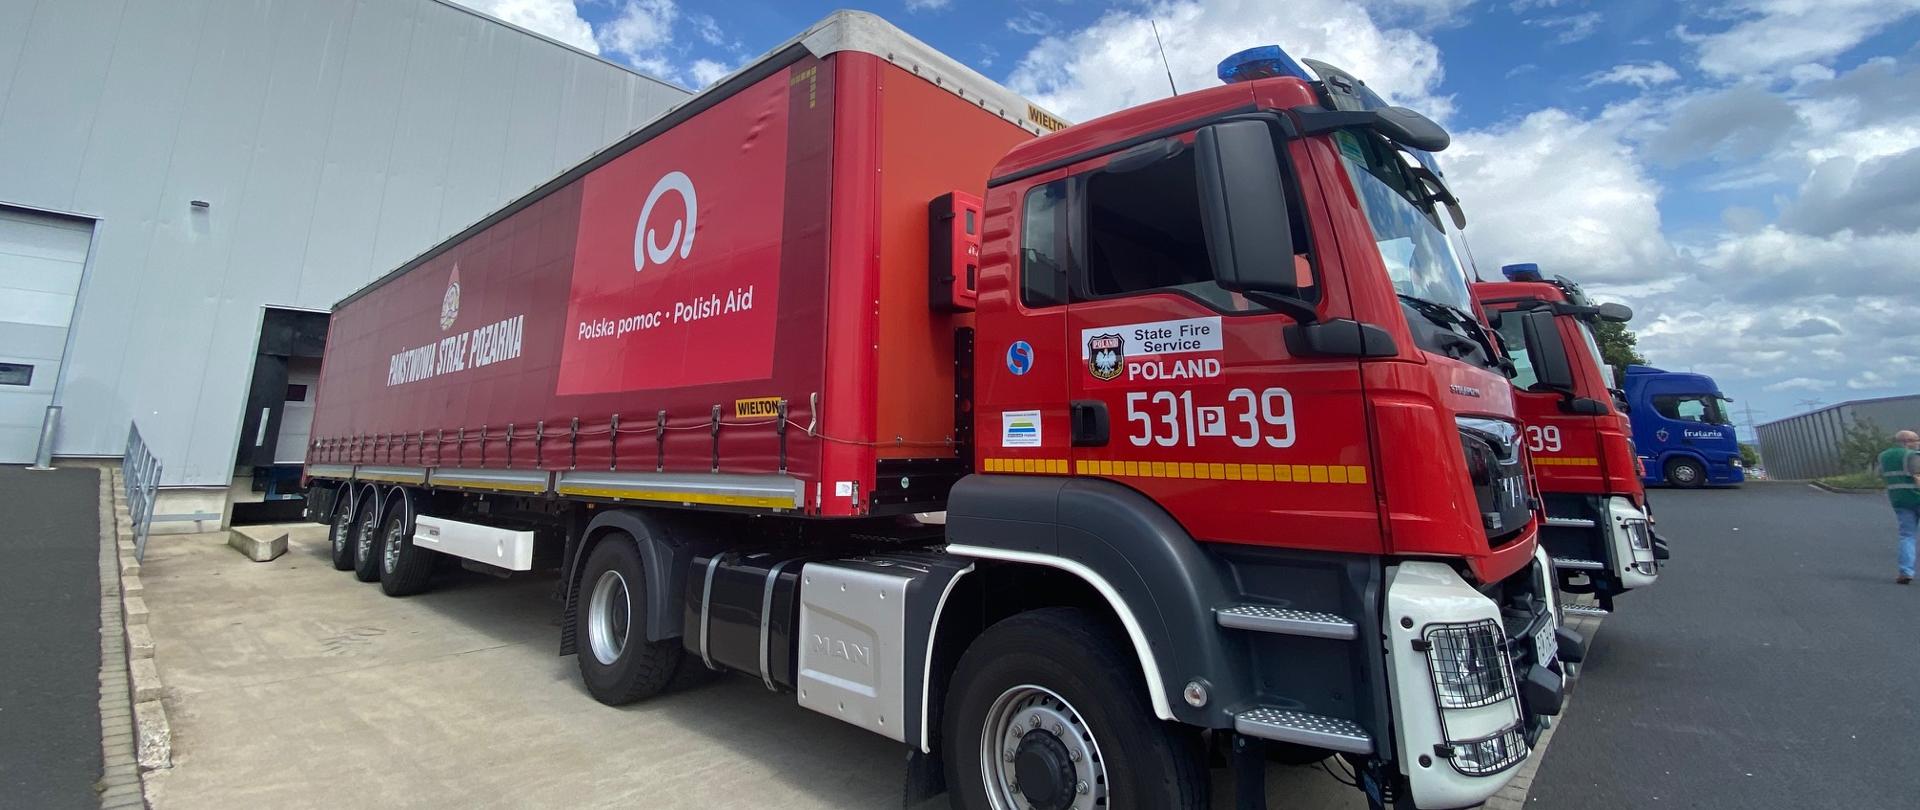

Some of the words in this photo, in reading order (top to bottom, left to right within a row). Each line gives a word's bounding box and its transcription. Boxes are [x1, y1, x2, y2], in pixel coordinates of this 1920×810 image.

[578, 317, 615, 341] Polska
[617, 310, 661, 339] pomoc
[674, 294, 720, 324] Polish
[724, 285, 753, 314] Aid
[1134, 328, 1172, 341] State
[1179, 324, 1210, 338] Fire
[1144, 339, 1201, 353] Service
[1128, 358, 1221, 381] POLAND
[738, 401, 779, 415] WIELTON
[1126, 390, 1196, 447] 531
[1228, 387, 1296, 448] 39
[813, 634, 869, 665] MAN
